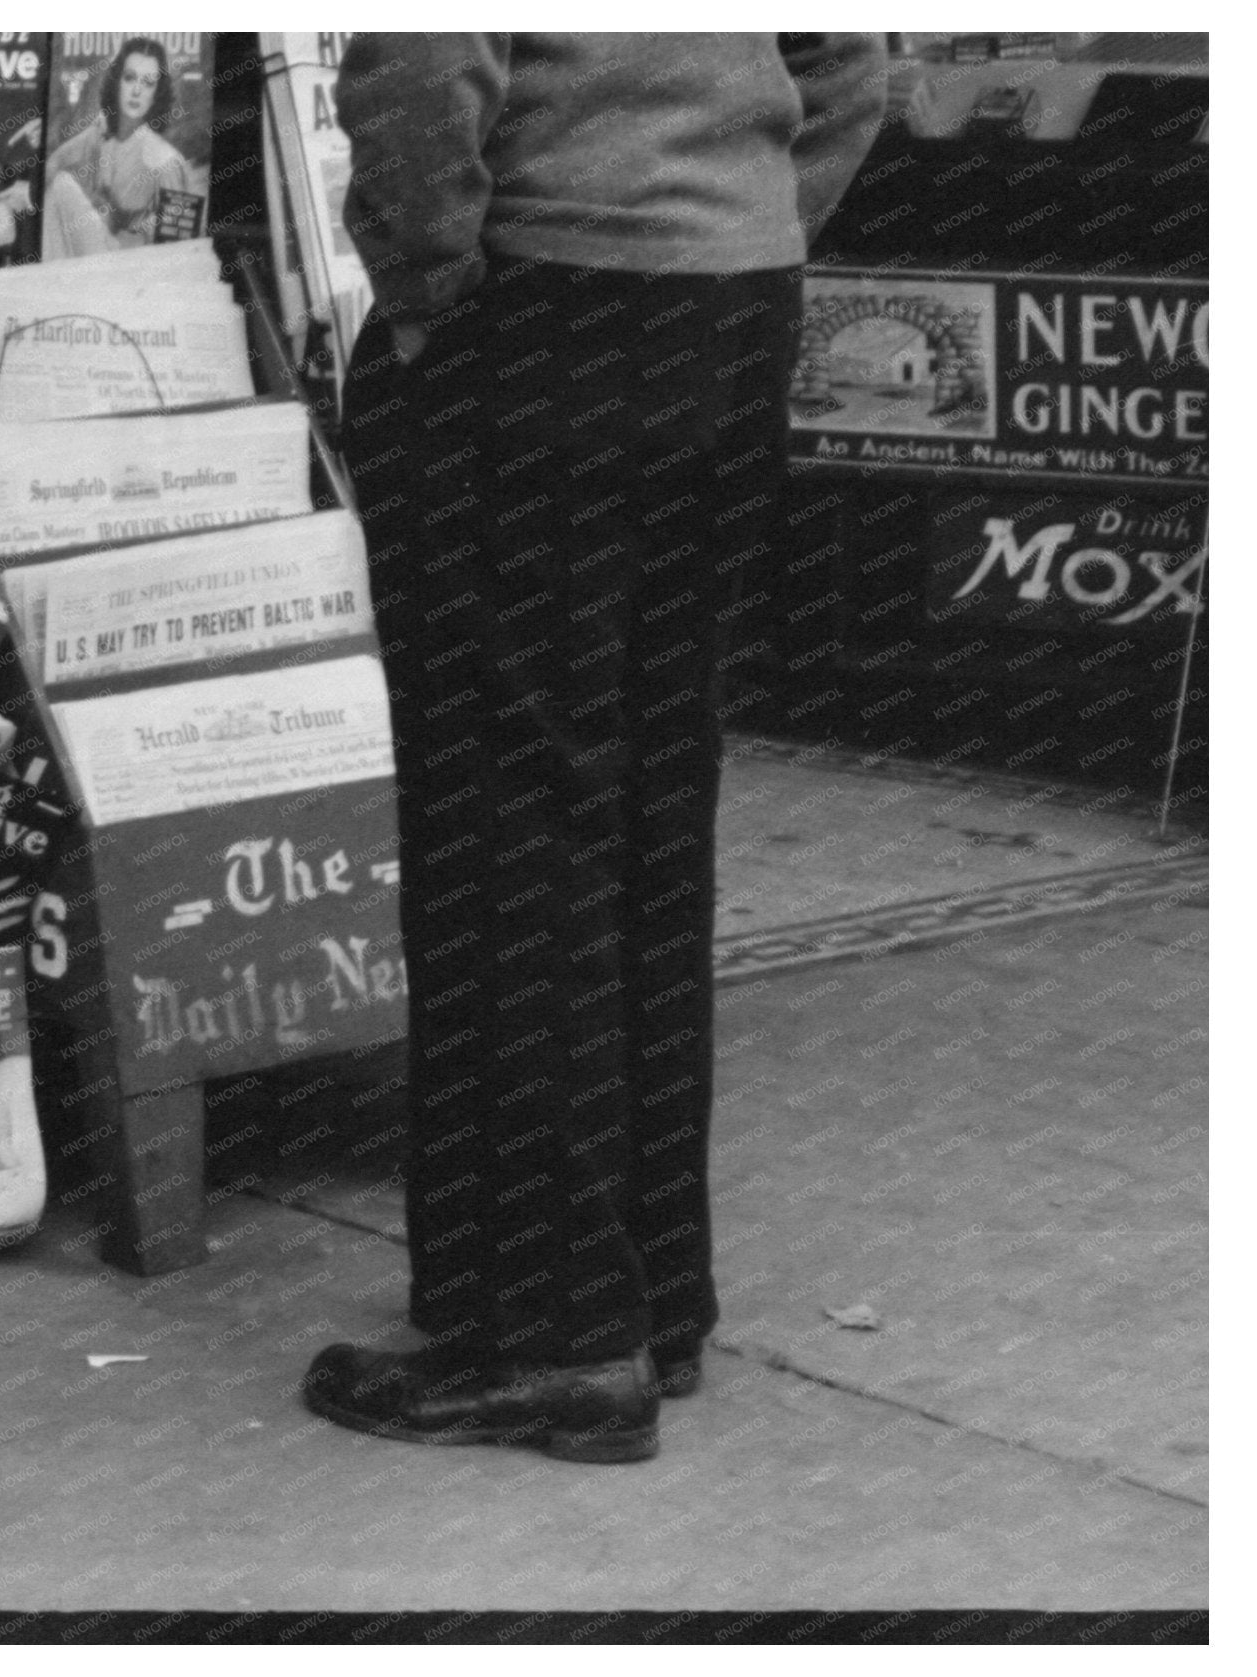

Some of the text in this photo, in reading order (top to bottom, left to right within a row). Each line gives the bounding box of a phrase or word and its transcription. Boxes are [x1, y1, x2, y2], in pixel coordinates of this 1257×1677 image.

[859, 437, 957, 464] Ancient
[28, 476, 108, 502] Springfield
[161, 468, 238, 492] Republican
[1095, 508, 1193, 541] Drink
[95, 631, 126, 657] MAY
[131, 624, 158, 649] TRY
[165, 618, 185, 643] TO
[191, 606, 256, 640] PREVENT
[263, 598, 315, 629] BALTIC
[320, 589, 356, 618] WAR
[136, 704, 348, 753] Herald Tribune
[224, 836, 355, 916] The
[132, 960, 310, 1056] Daily
